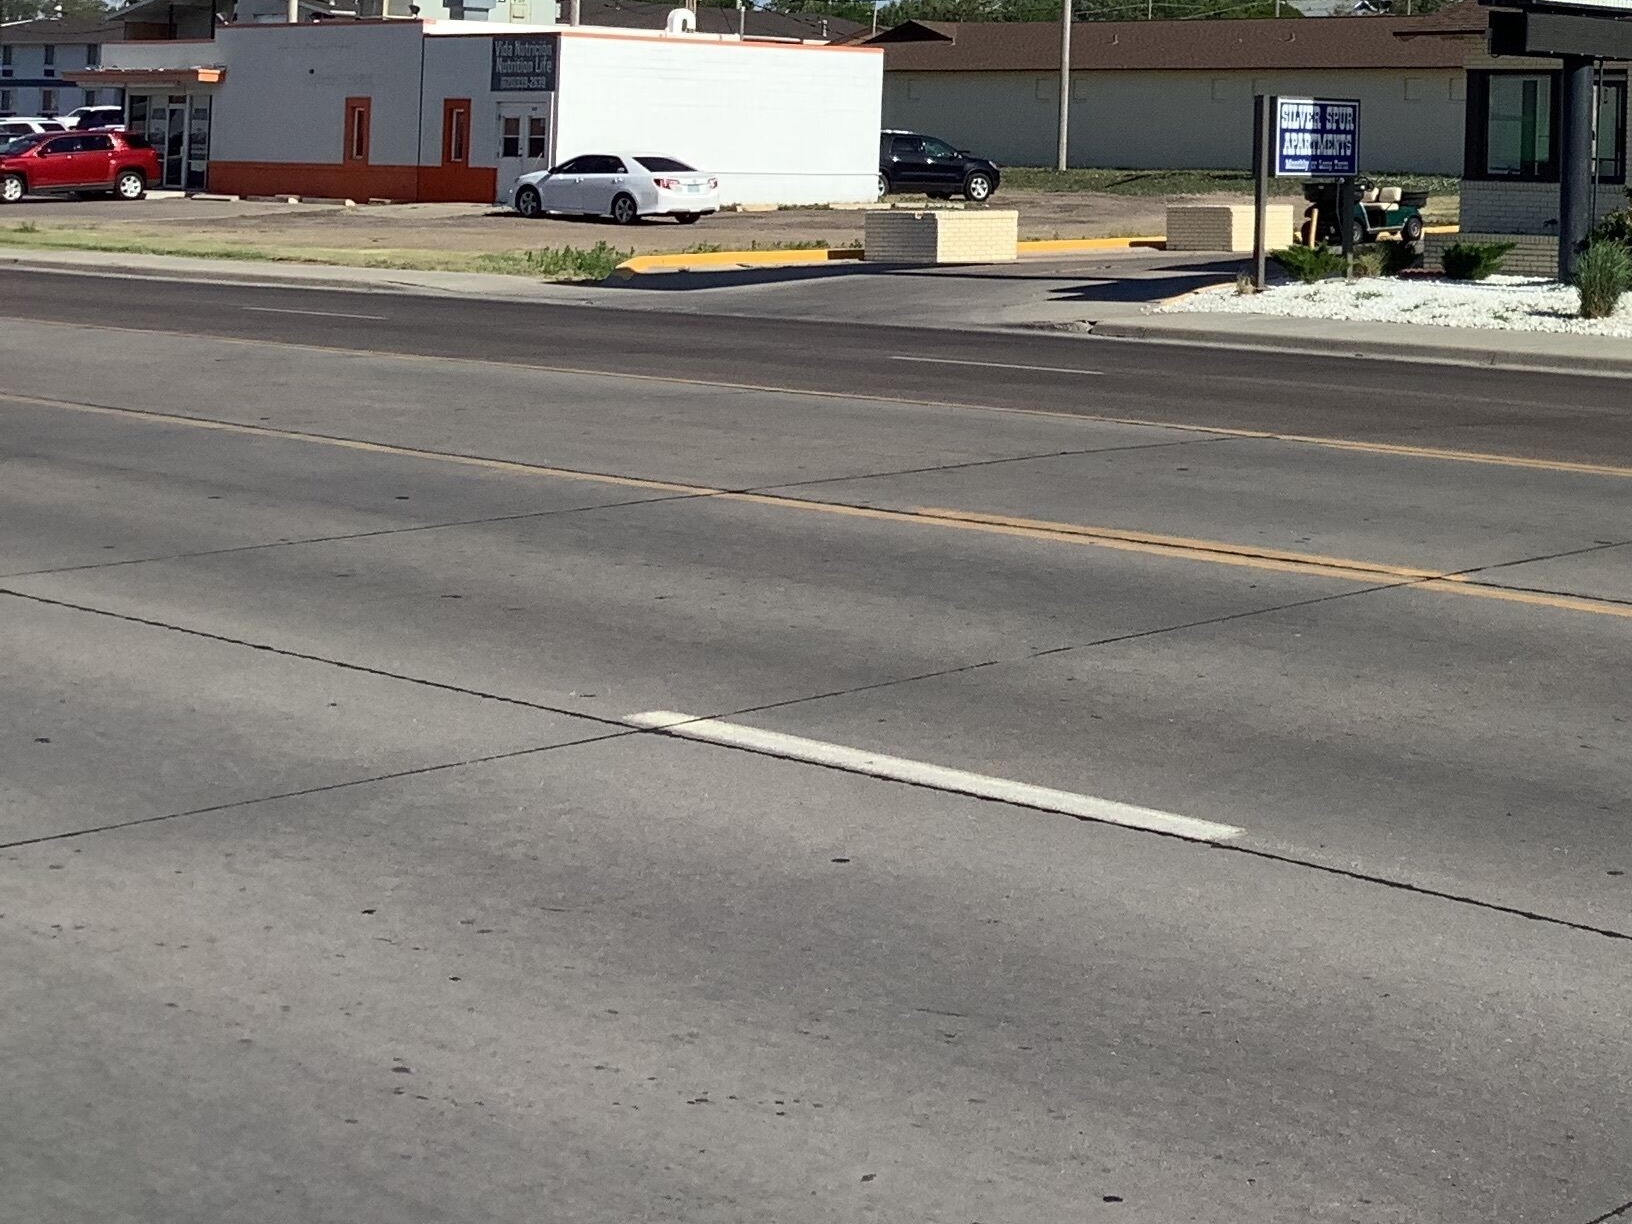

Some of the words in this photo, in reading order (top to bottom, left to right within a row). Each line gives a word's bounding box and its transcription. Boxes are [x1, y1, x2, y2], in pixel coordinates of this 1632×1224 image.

[495, 40, 513, 57] Vida
[495, 57, 534, 73] Nutrition
[535, 56, 553, 73] Life
[1281, 103, 1322, 130] SILVER
[1326, 105, 1354, 131] SPUR
[1282, 131, 1352, 156] APARTMENTS
